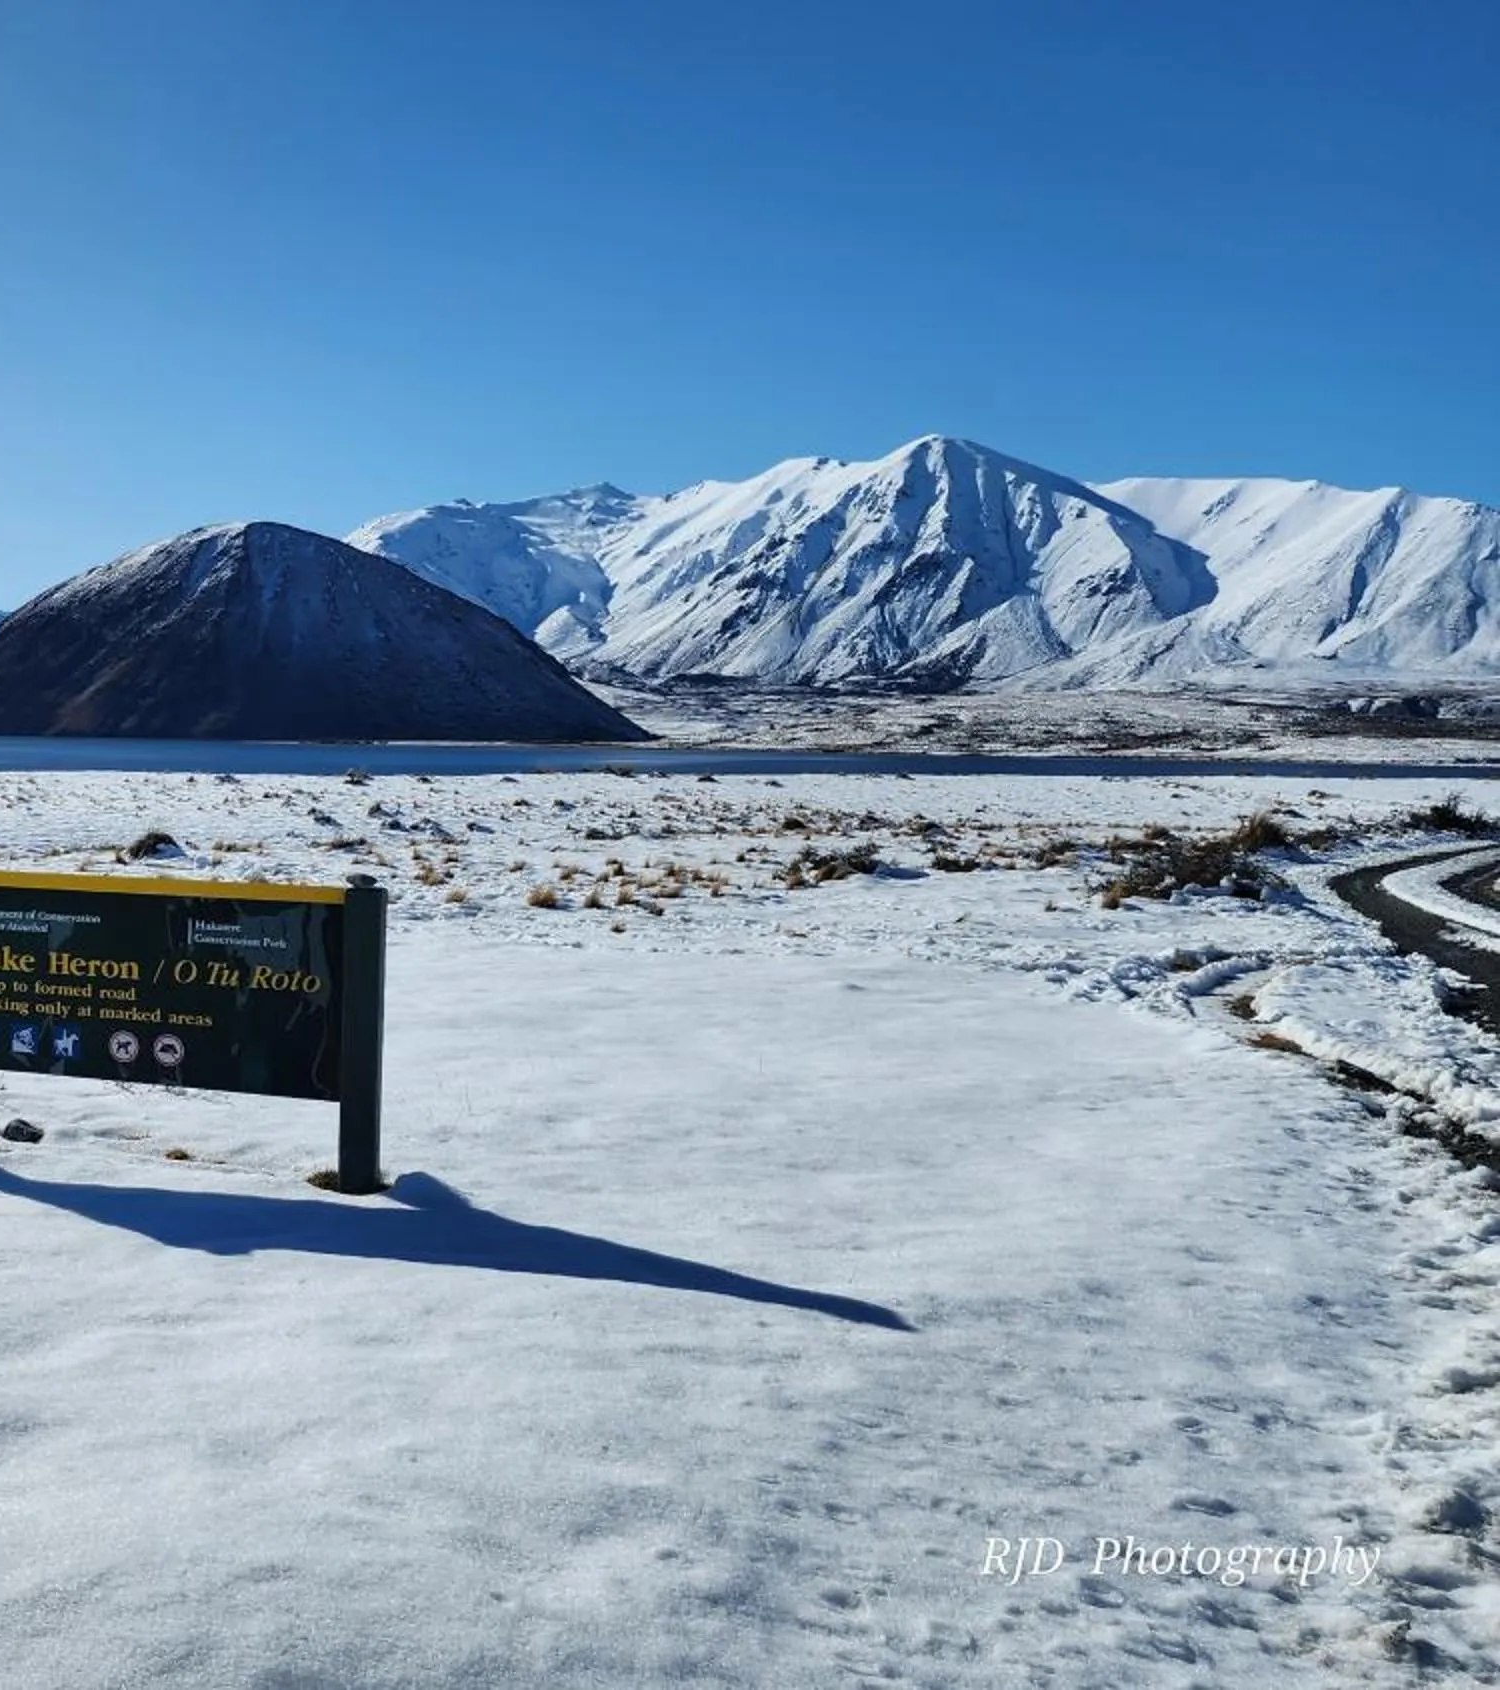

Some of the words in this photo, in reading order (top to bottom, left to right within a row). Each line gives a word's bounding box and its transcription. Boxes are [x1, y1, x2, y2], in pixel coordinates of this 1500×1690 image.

[26, 910, 36, 920] of
[263, 937, 287, 949] Park
[48, 951, 140, 981] Heron
[153, 959, 165, 984] /
[173, 959, 198, 984] O
[205, 960, 239, 987] Tu
[251, 965, 321, 993] Roto
[13, 980, 28, 993] to
[35, 980, 92, 998] formed
[99, 987, 136, 1001] road
[35, 1001, 71, 1018] only
[77, 1004, 91, 1017] at
[99, 1006, 161, 1023] marked
[168, 1012, 213, 1027] areas
